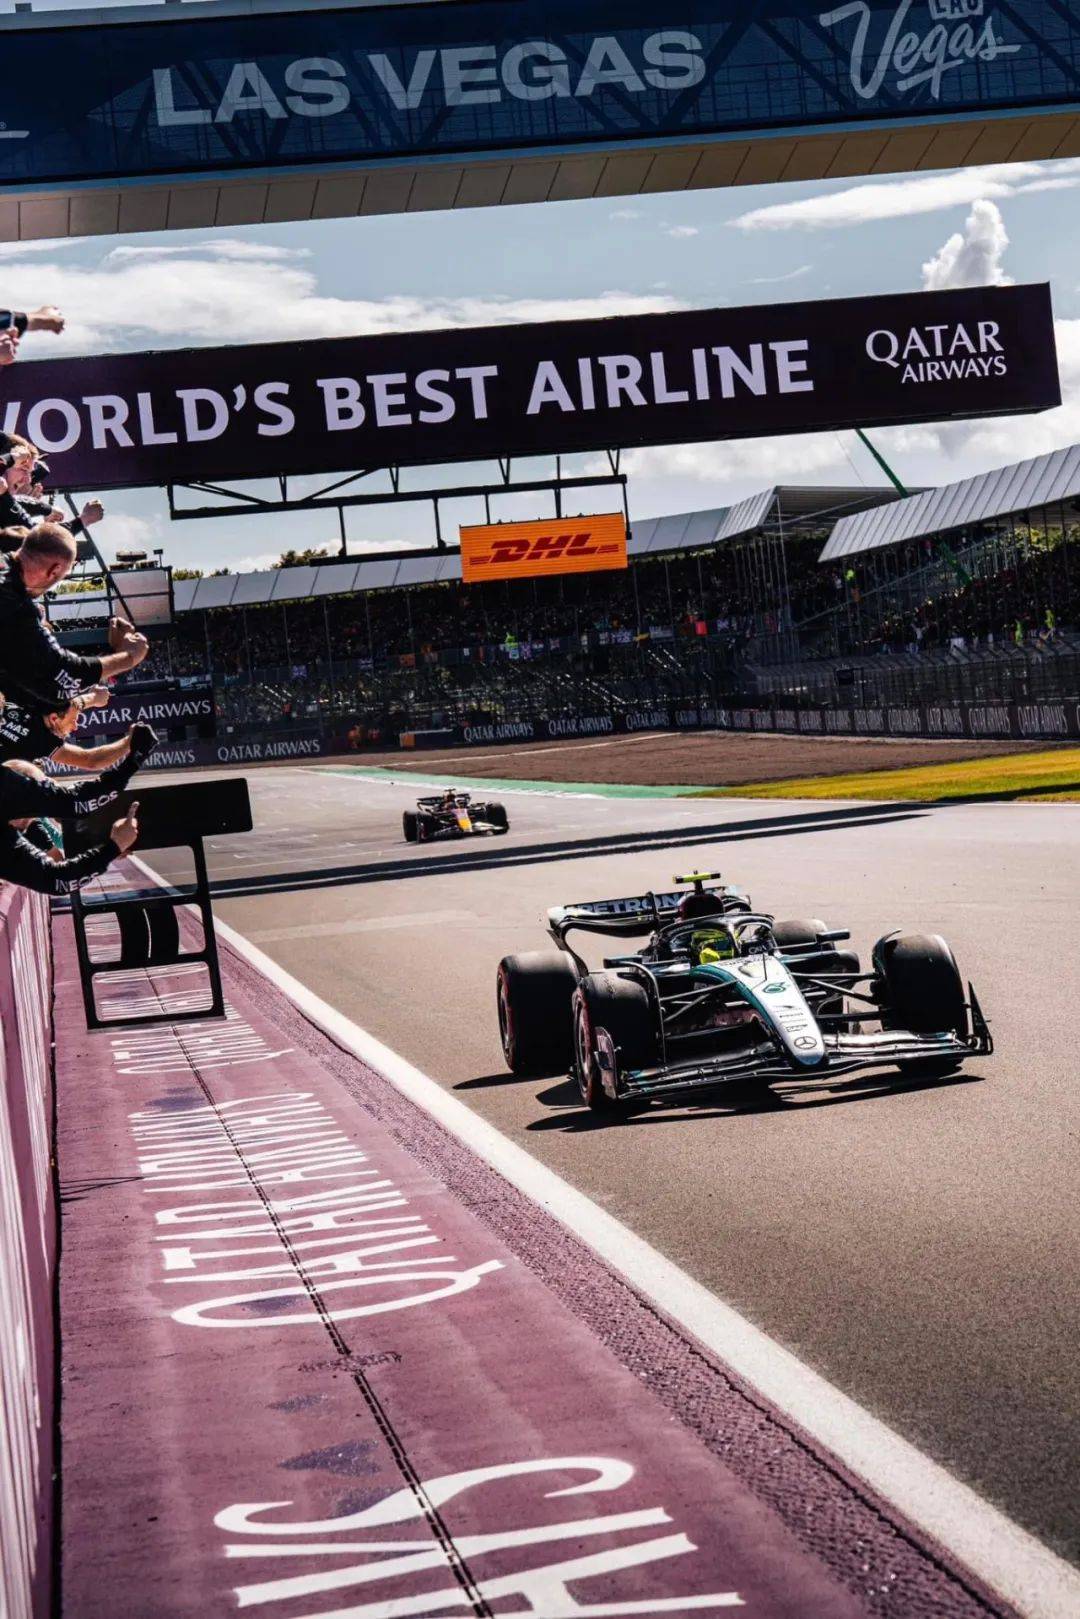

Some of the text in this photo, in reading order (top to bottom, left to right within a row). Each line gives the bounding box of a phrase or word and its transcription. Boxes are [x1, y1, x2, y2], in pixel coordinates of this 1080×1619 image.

[819, 0, 1021, 99] Vegas
[153, 30, 706, 127] LAS VEGAS
[865, 319, 1004, 368] QATAR
[901, 355, 1007, 384] AIRWAYS
[0, 338, 815, 454] ORLD’S BEST AIRLINE
[489, 533, 599, 564] DHL
[75, 699, 212, 729] QATAR AIRWAYS
[463, 720, 534, 742] QATAR AIRWAYS
[217, 738, 321, 763] QATAR AIRWAYS
[74, 789, 119, 814] INEOS
[126, 1092, 381, 1193] AIRWAYS
[154, 1178, 506, 1327] QATAR
